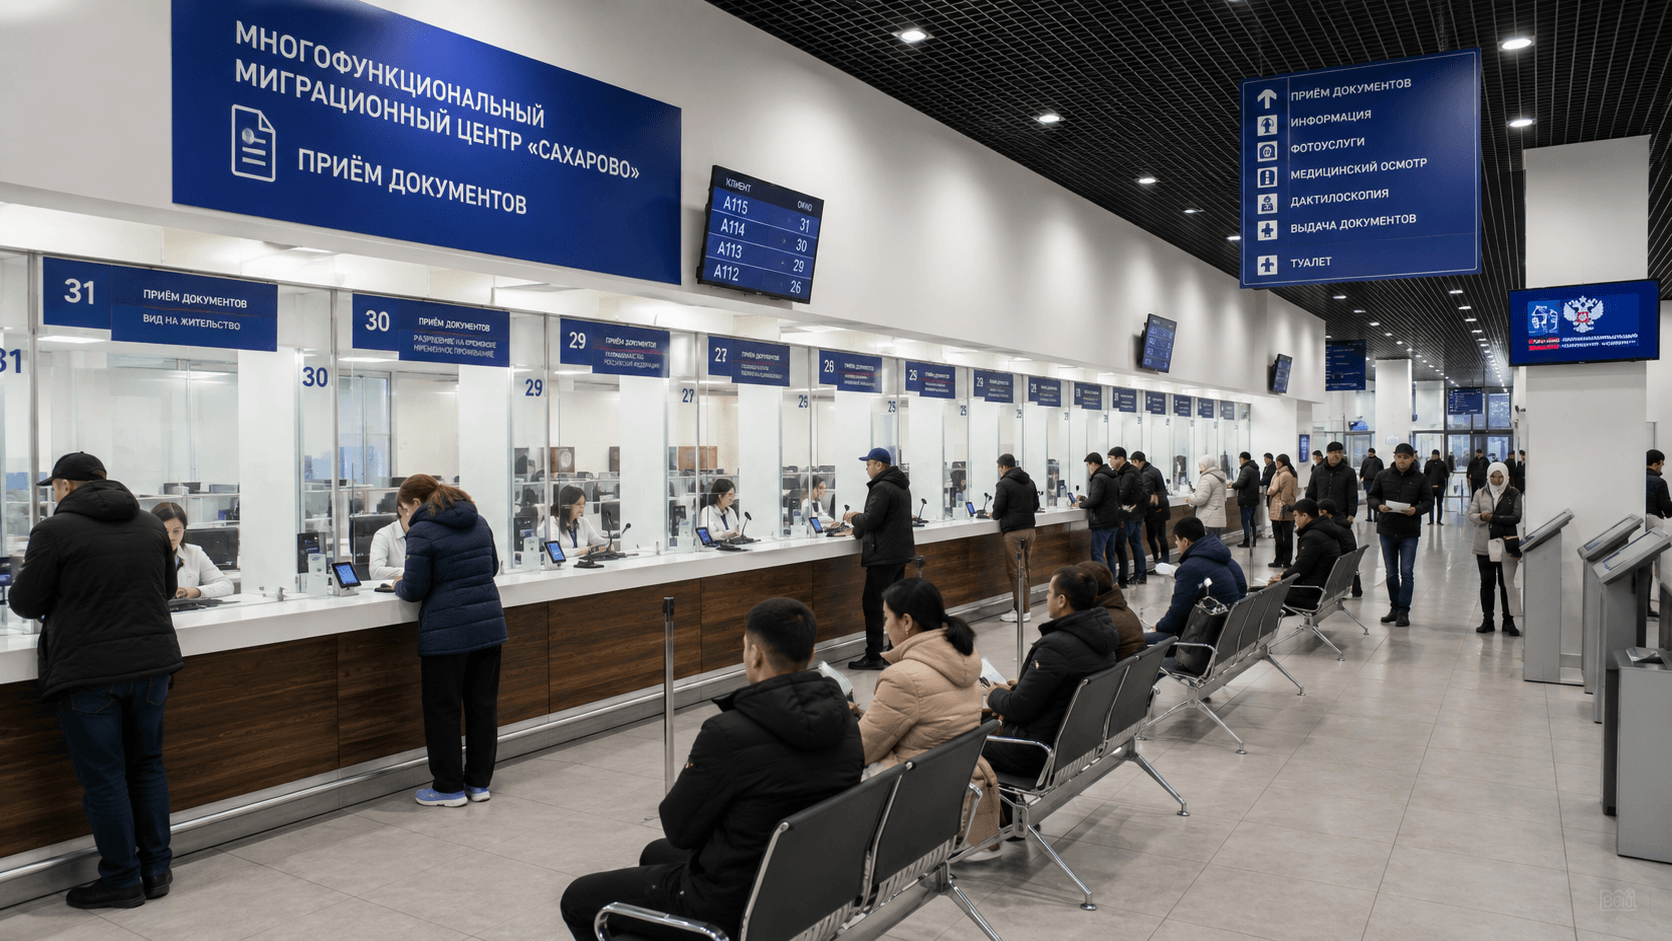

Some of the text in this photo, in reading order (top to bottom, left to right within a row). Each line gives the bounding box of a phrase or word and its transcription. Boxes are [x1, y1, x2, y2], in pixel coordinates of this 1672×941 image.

[235, 20, 546, 130] МНОГОФУНКЦИОНАЛЬНЫЙ
[1290, 78, 1412, 102] ПРИЁМ ДОКУМЕНТОВ
[234, 58, 640, 180] МИГРАЦИОННЫЙ ЦЕНТР «САХАРОВО»
[1290, 108, 1372, 128] ИНФОРМАЦИЯ
[1290, 136, 1365, 155] ФОТОУСЛУГИ
[1290, 157, 1428, 181] МЕДИЦИНСКИЙ ОСМОТР
[298, 147, 528, 216] ПРИЁМ ДОКУМЕНТОВ
[1290, 188, 1389, 209] ДАКТИЛОСКОПИЯ
[799, 217, 811, 233] 31
[1290, 213, 1417, 235] ВЫДАЧА ДОКУМЕНТОВ
[795, 238, 808, 253] 30
[792, 258, 805, 273] 29
[1290, 256, 1332, 269] ТУАЛЕТ
[64, 278, 95, 305] 31
[790, 280, 802, 294] 26
[143, 288, 248, 309] ПРИЁМ ДОКУМЕНТОВ
[143, 313, 242, 331] ВИД НА ЖИТЕЛЬСТВО
[365, 309, 391, 333] 30
[569, 331, 587, 350] 29
[302, 366, 329, 388] 30
[525, 378, 544, 397] 29
